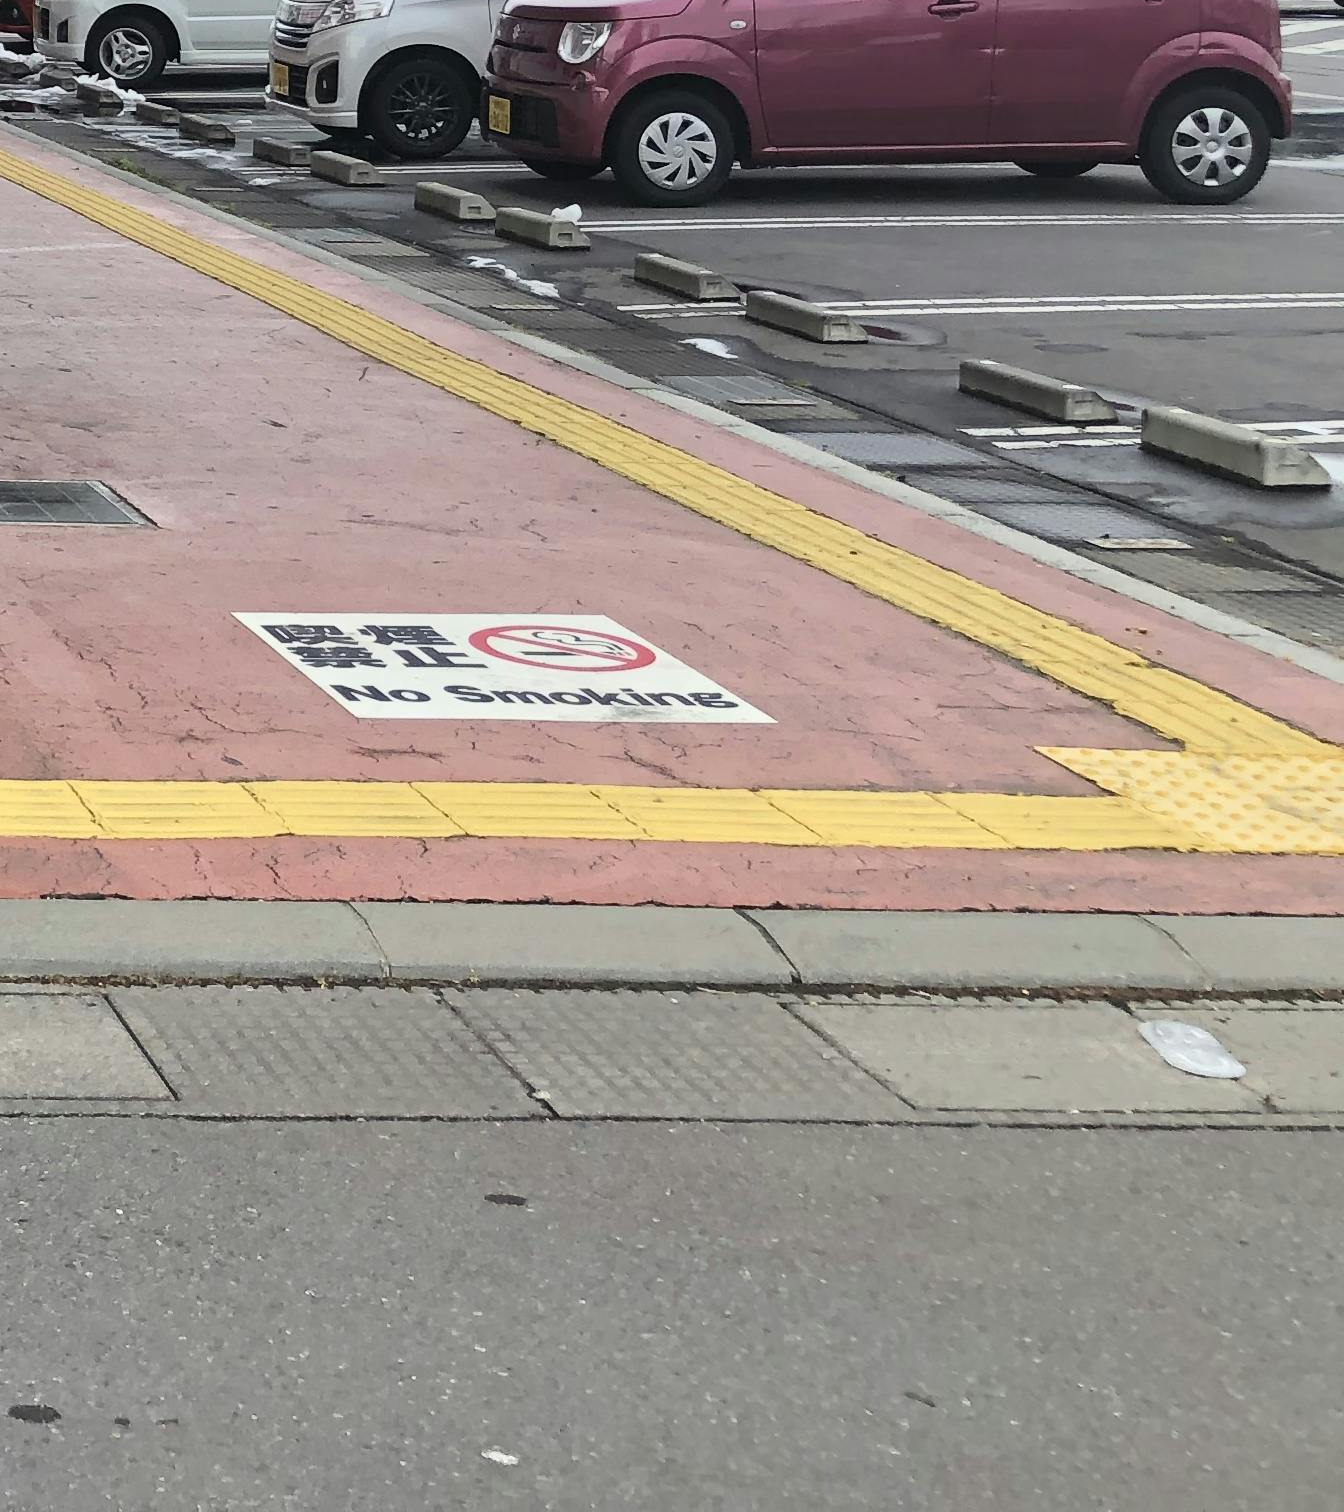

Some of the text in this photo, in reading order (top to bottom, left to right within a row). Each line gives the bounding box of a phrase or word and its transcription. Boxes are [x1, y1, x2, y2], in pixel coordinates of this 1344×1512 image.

[260, 624, 457, 646] 喫煙
[286, 646, 489, 669] 禁止
[329, 684, 740, 710] No Smoking
